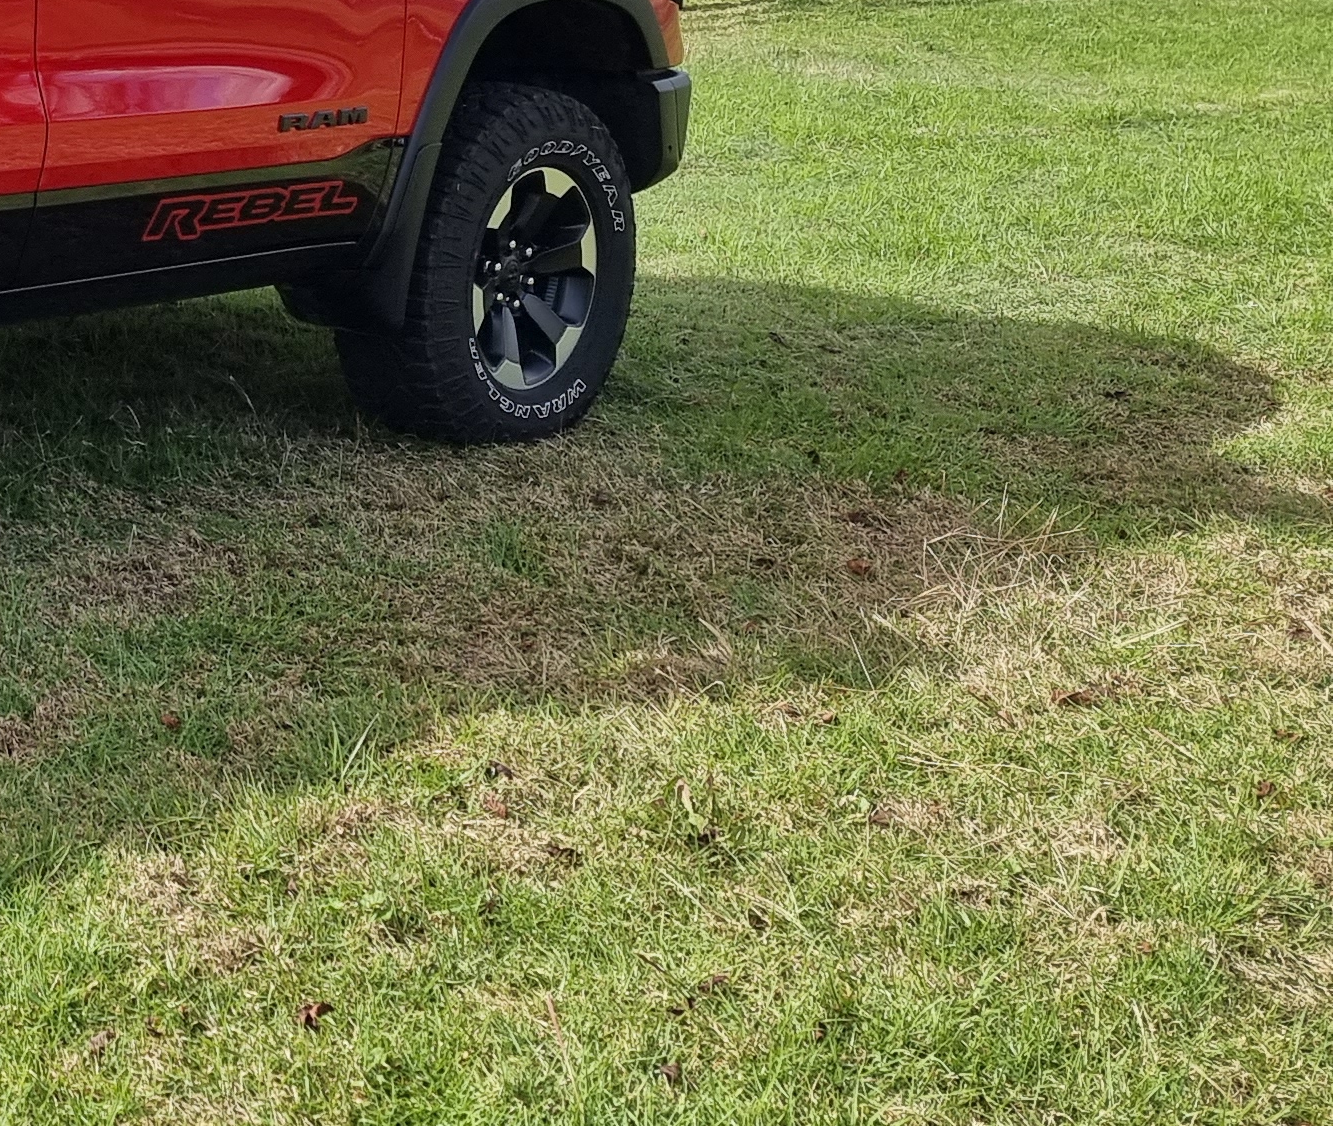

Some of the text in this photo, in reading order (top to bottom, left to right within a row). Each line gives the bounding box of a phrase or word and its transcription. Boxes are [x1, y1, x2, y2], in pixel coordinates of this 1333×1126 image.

[277, 107, 368, 133] RAM
[141, 180, 358, 242] REBEL
[506, 139, 626, 233] GOODYEAR
[468, 337, 587, 419] WRANGLER
